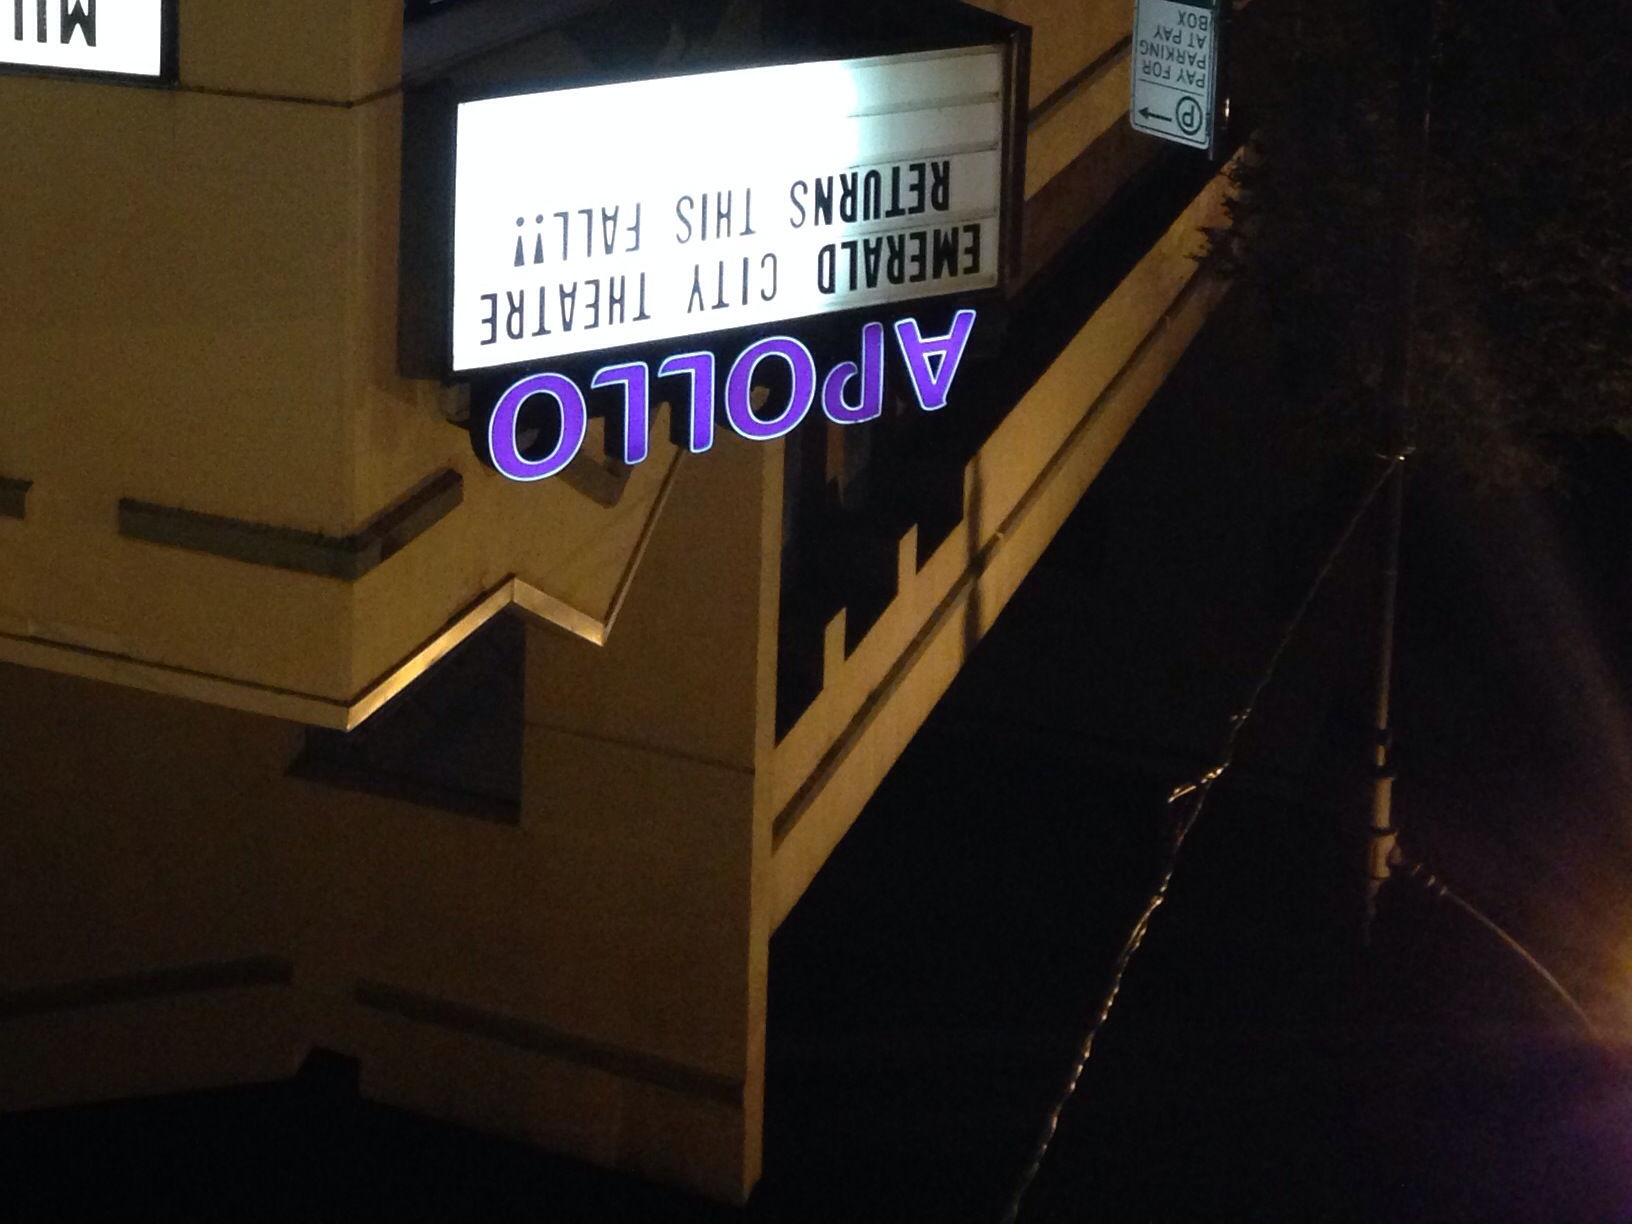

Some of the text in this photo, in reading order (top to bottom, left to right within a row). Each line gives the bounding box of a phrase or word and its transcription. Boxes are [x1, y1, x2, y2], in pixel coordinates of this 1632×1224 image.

[1153, 24, 1207, 50] AT PAY
[1177, 10, 1208, 32] BOX
[1139, 38, 1207, 70] PARKING
[1142, 59, 1206, 89] PAY FOR
[513, 160, 950, 267] RETURNS THIS FALL!!
[479, 223, 981, 346] EMERALD CITY THEATRE
[488, 309, 977, 482] APOLLO
